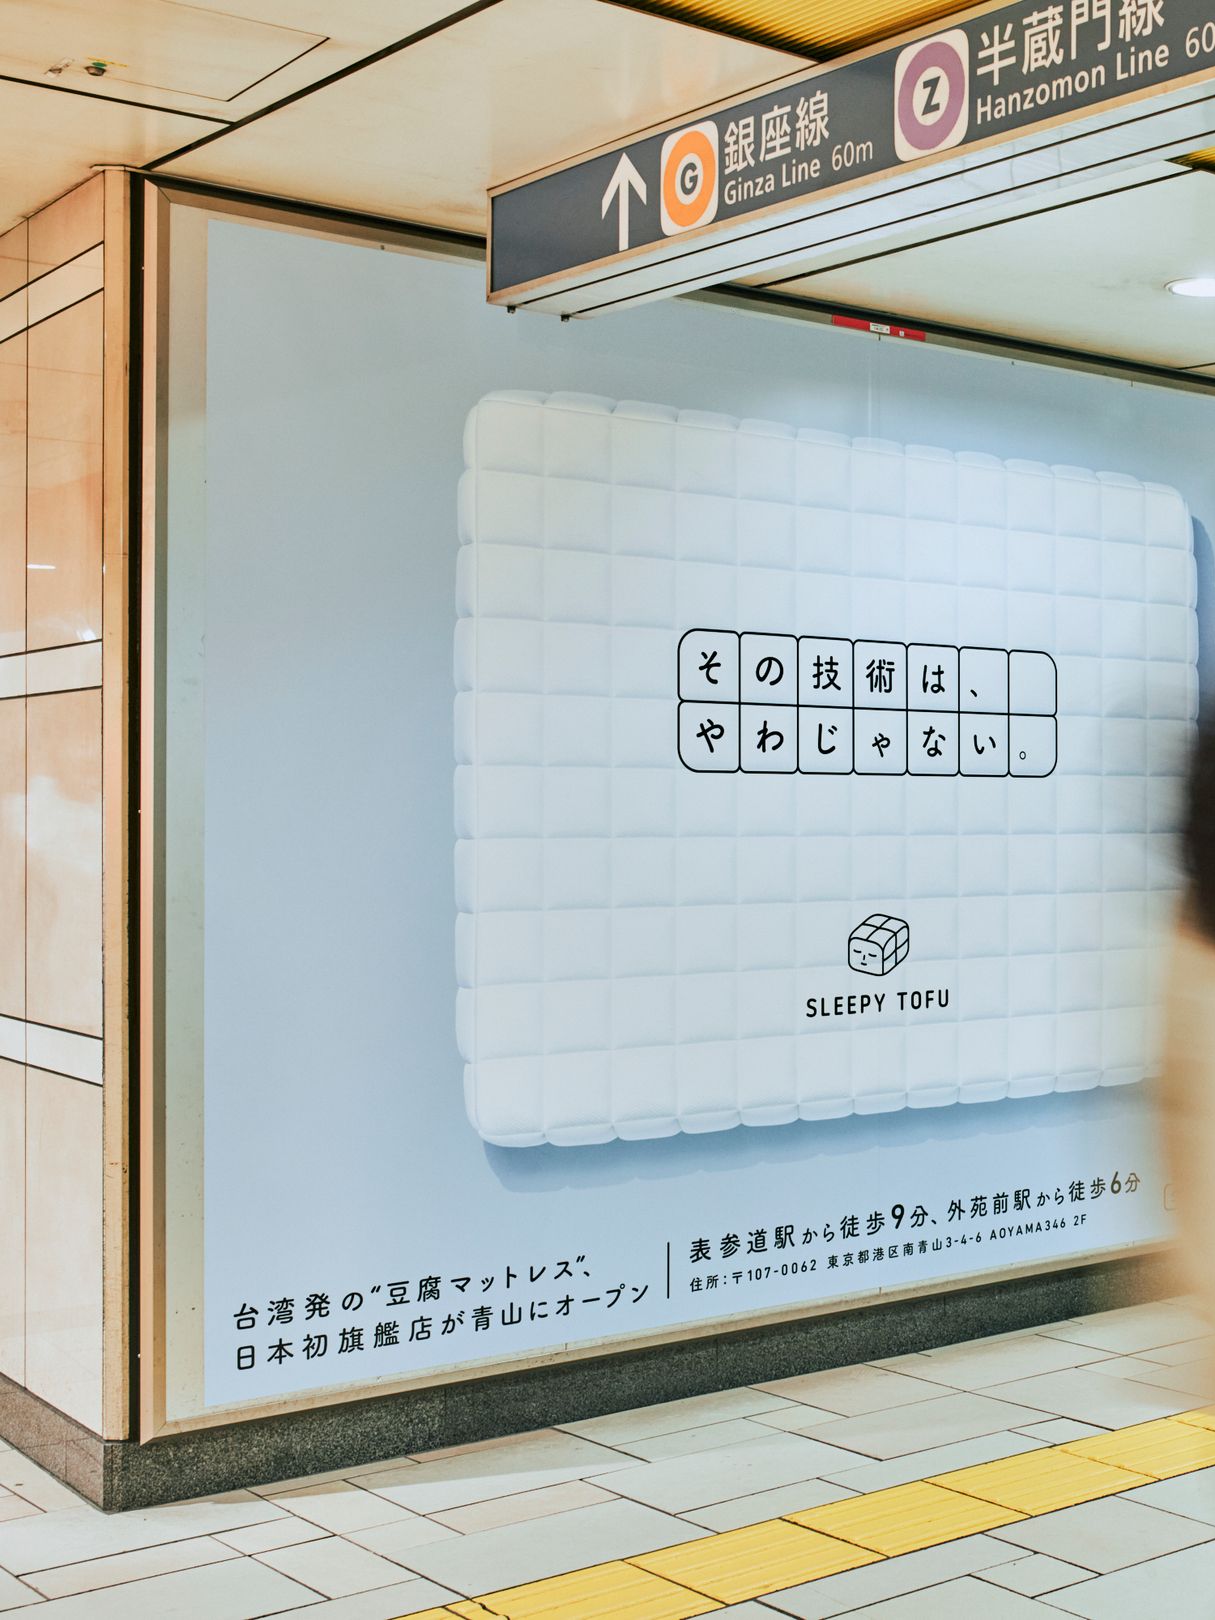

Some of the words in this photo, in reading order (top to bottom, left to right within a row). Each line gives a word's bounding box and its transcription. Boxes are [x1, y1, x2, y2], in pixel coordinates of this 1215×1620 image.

[977, 0, 1164, 85] 半蔵門線
[921, 75, 942, 117] Z
[976, 64, 1105, 125] Hanzomon
[1116, 41, 1170, 81] Line
[723, 89, 830, 176] 銀座線
[680, 161, 699, 196] G
[723, 173, 775, 205] Ginza
[781, 157, 821, 188] Line
[831, 139, 873, 171] 60m
[698, 650, 978, 698] その技術は、
[695, 718, 1027, 760] やわじゃない。
[805, 993, 886, 1018] SLEEPY
[896, 988, 950, 1011] TOFU
[689, 1171, 1141, 1264] 表参道駅から徒歩9分、外苑前駅から徒歩6分
[826, 1231, 983, 1270] 東京都港区南青山3-4-6
[989, 1215, 1067, 1241] AOYAMA346
[1072, 1213, 1088, 1227] 2F
[235, 1283, 650, 1371] 日本初旗艦店が青山にオープン
